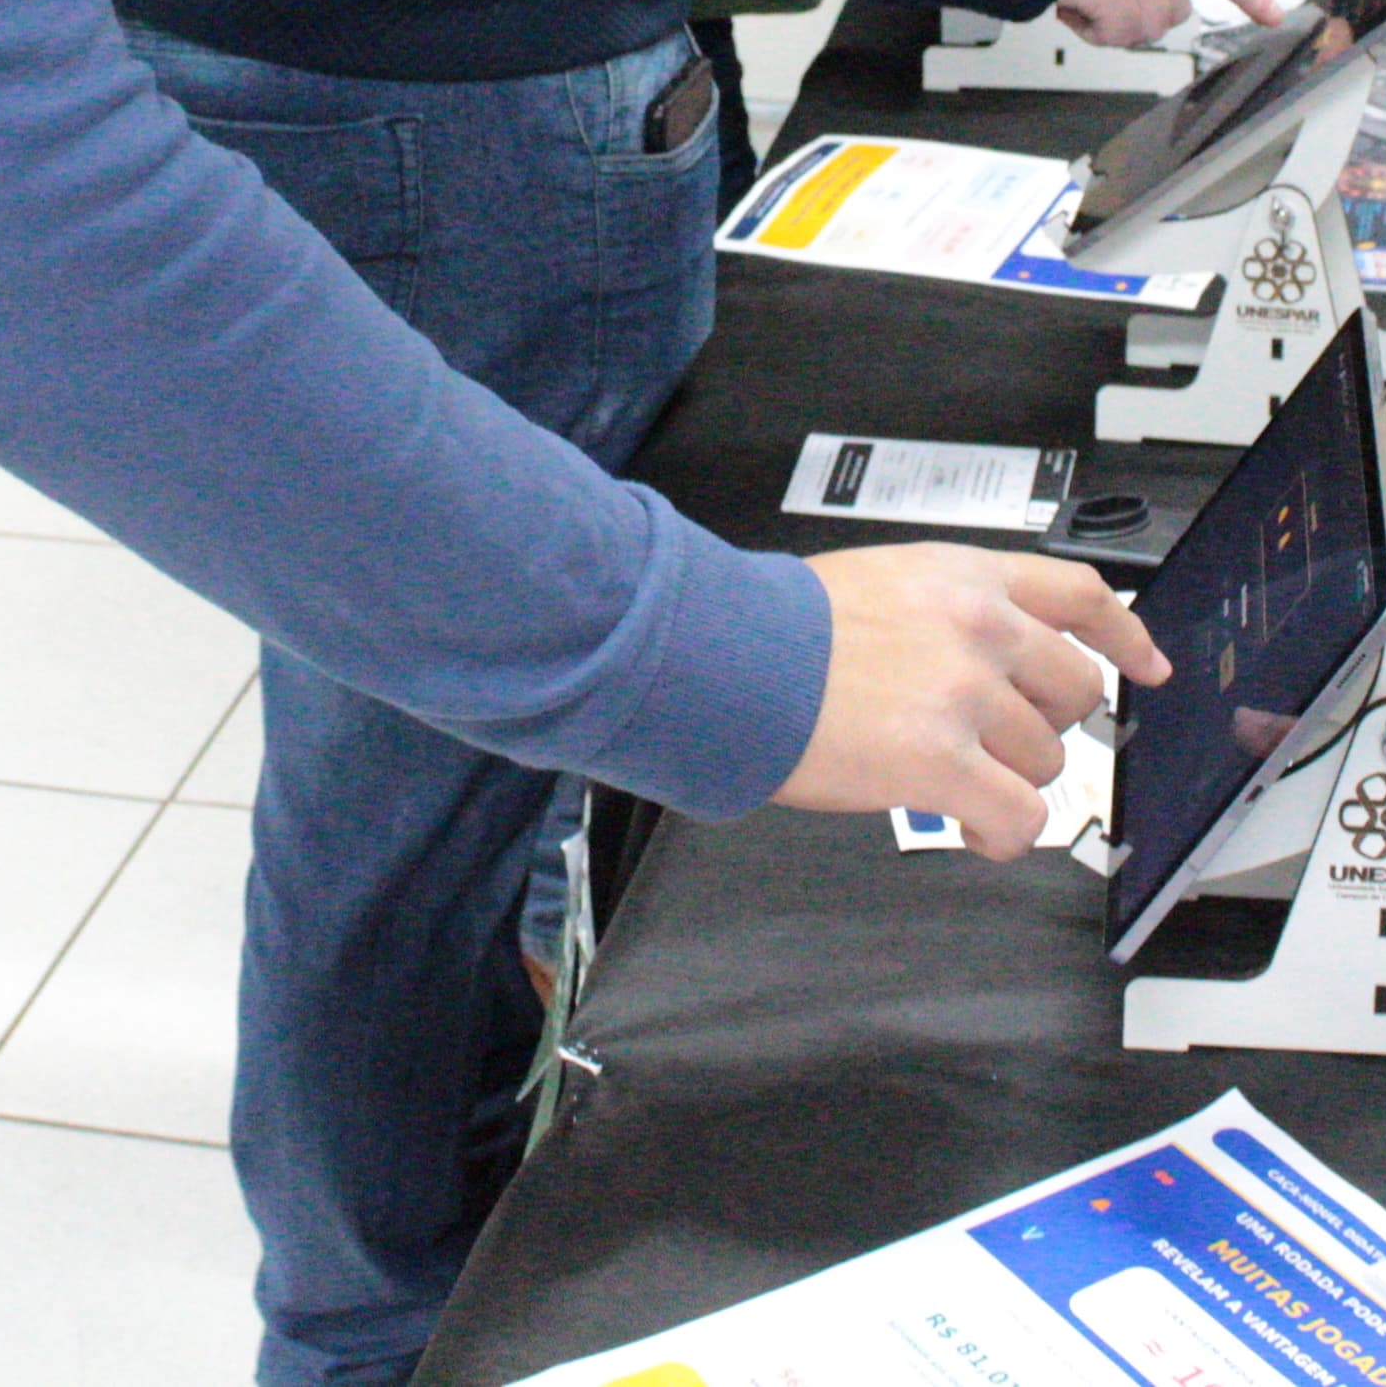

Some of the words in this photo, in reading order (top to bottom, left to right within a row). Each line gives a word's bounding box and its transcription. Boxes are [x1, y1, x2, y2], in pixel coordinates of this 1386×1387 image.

[1207, 1239, 1310, 1318] MUITAS
[1235, 1212, 1275, 1245] UMA
[1273, 1242, 1344, 1300] RODADA
[925, 1313, 957, 1339] R$
[957, 1342, 1019, 1387] 81,0
[1151, 1237, 1231, 1301] REVELAM
[1224, 1299, 1243, 1315] A
[1242, 1310, 1337, 1387] VANTAGEM
